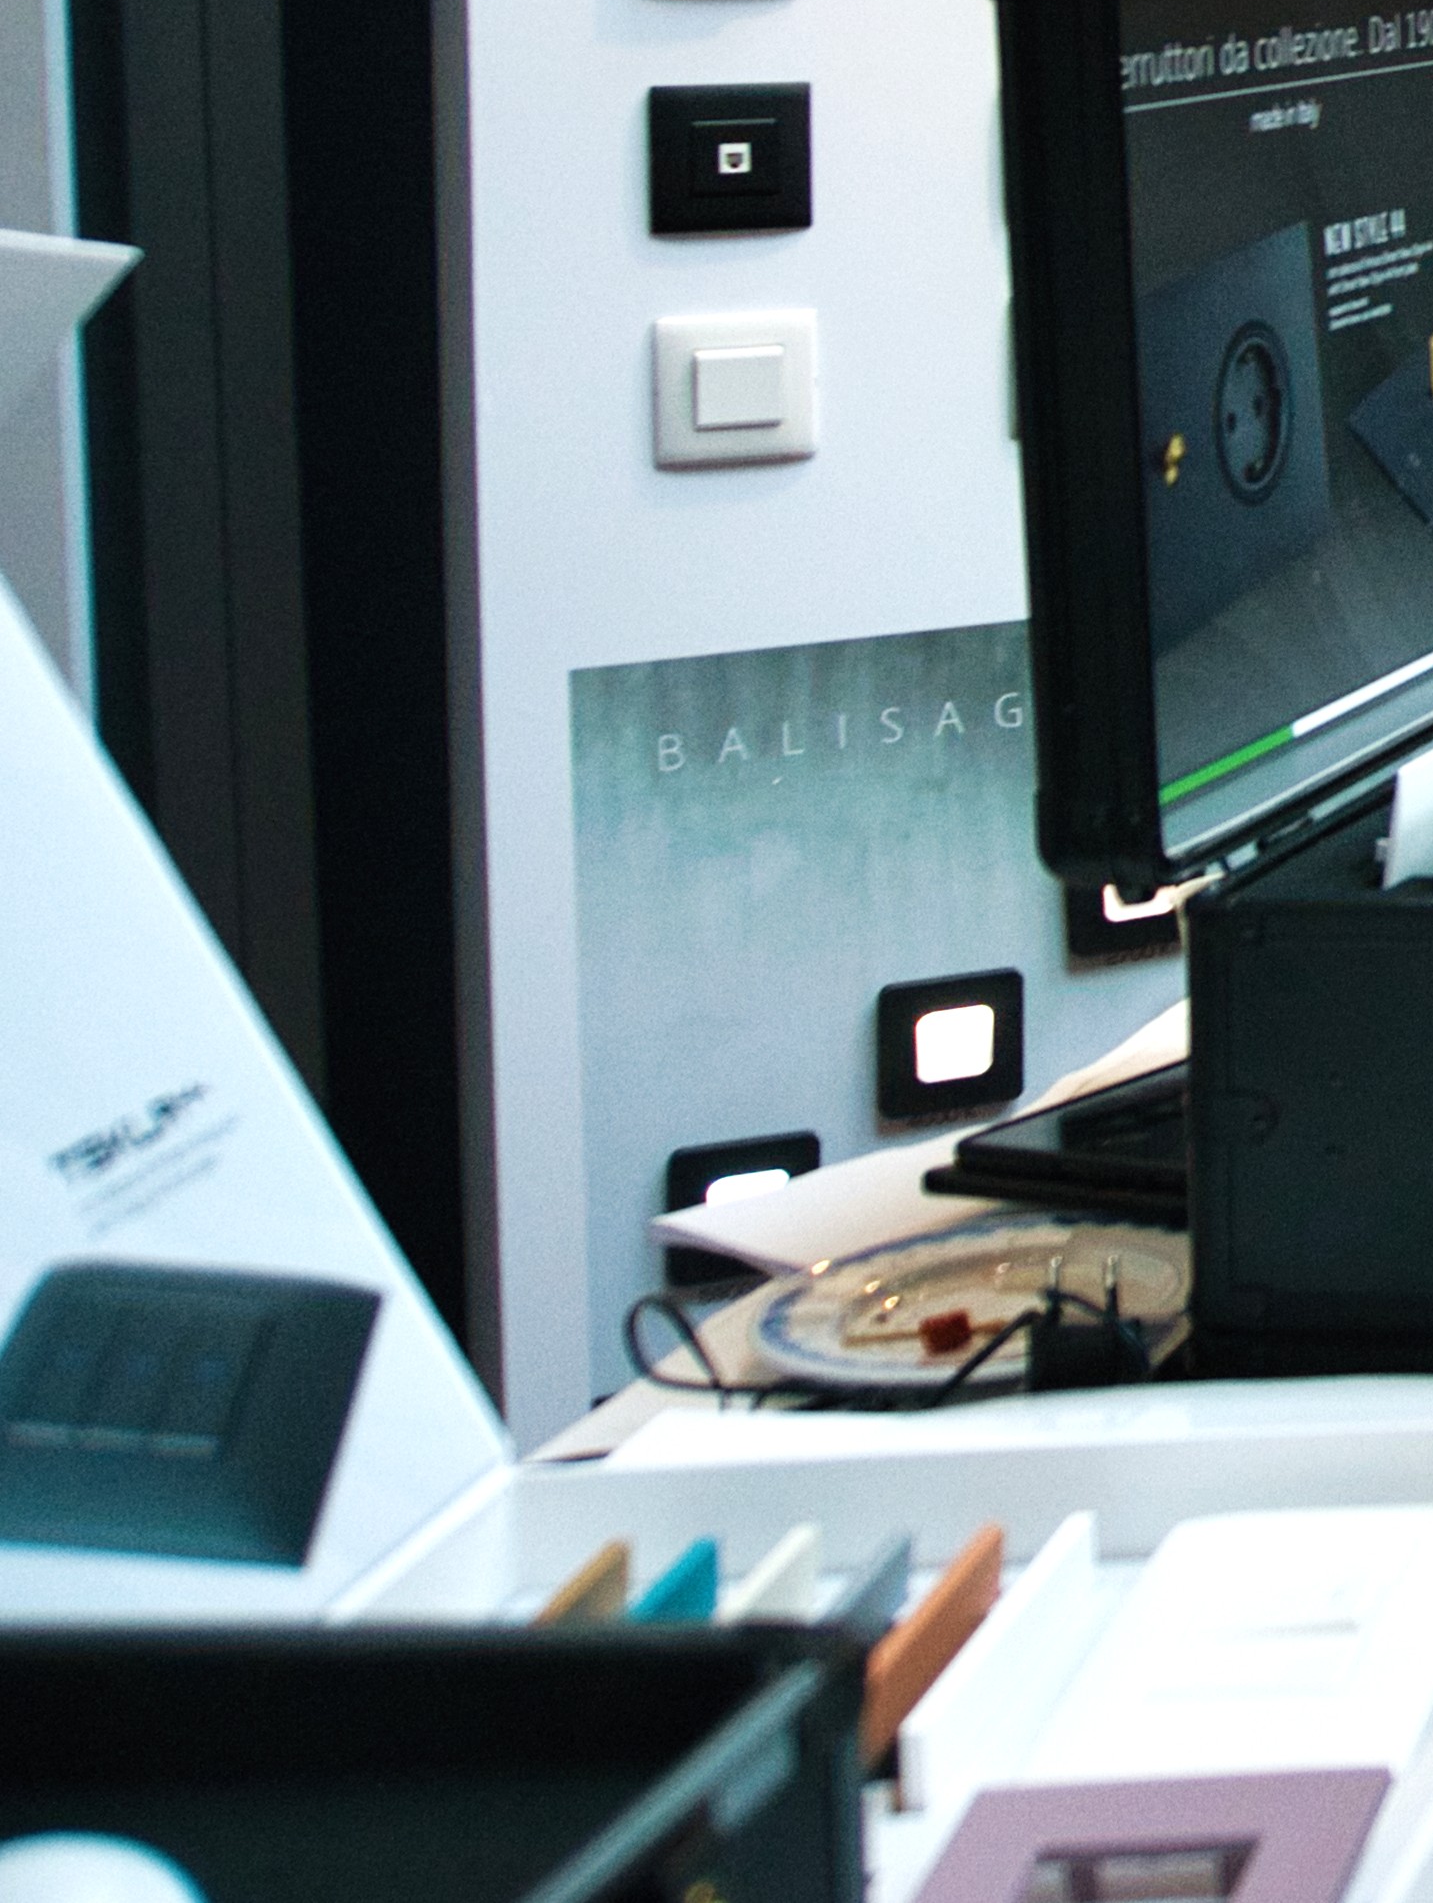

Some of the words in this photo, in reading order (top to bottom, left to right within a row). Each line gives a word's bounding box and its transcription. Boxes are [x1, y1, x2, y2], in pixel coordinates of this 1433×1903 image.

[1219, 33, 1250, 76] da
[1368, 14, 1401, 55] Dal
[657, 691, 1025, 773] BALISAG
